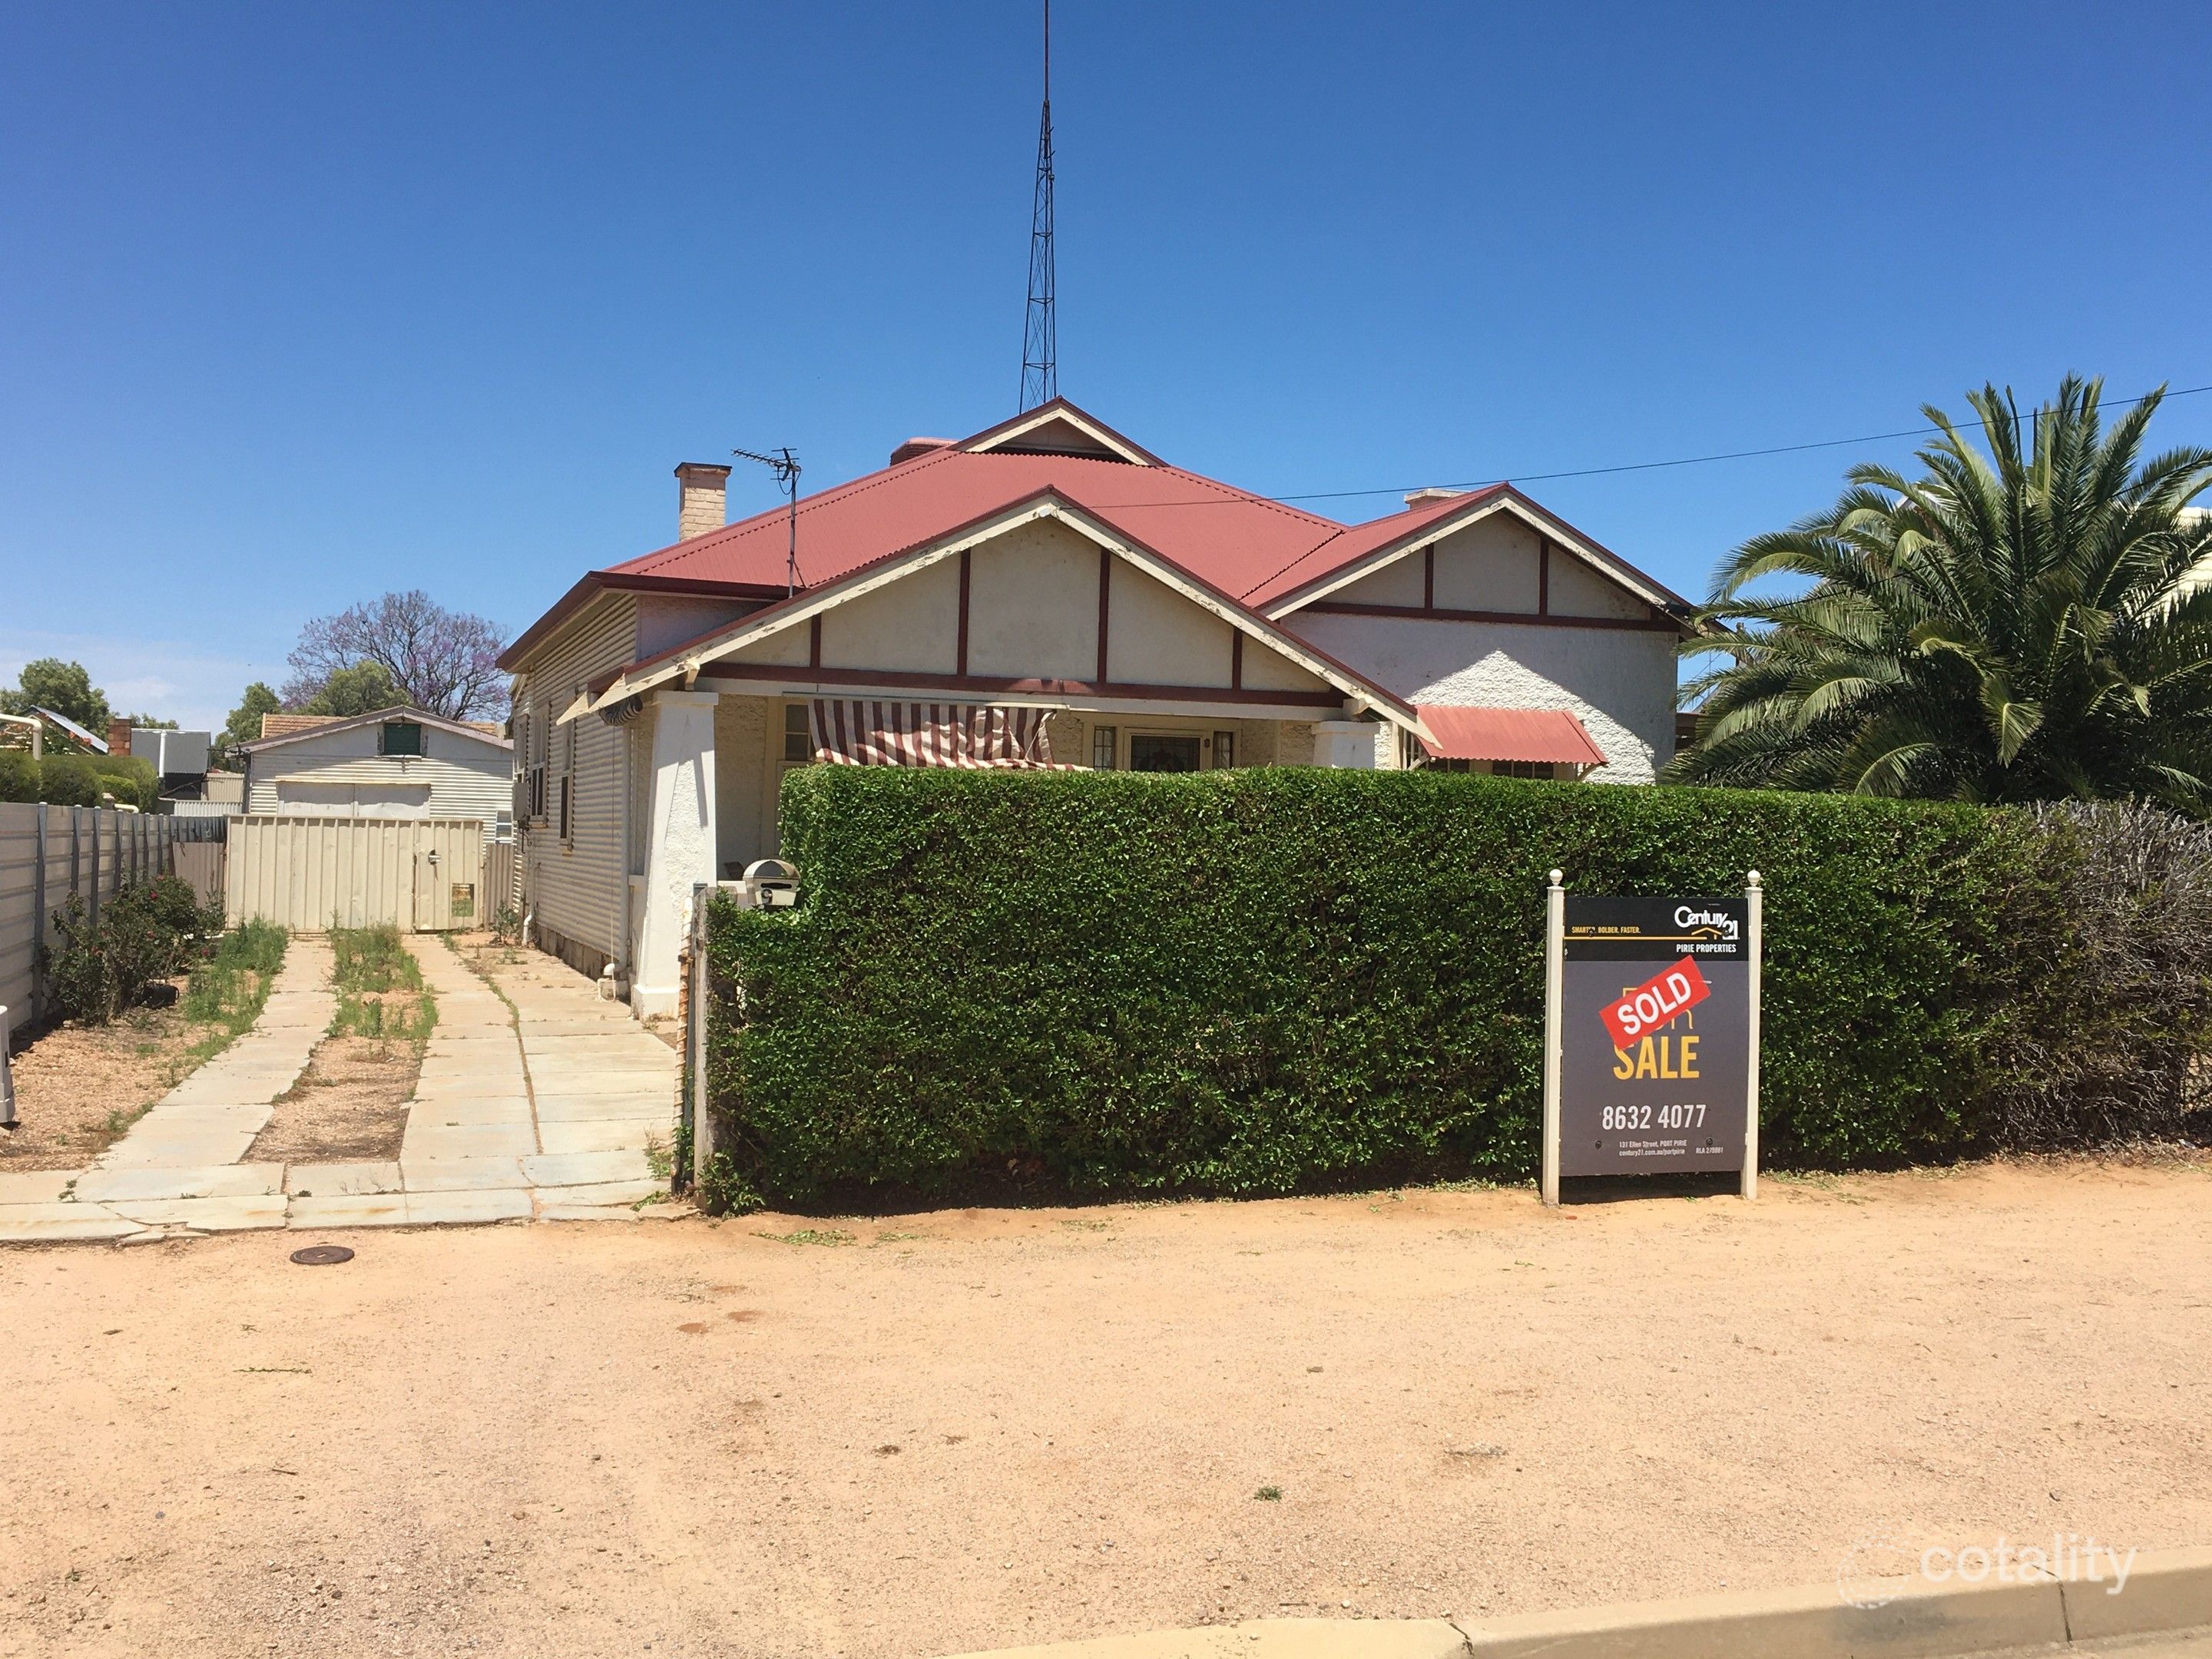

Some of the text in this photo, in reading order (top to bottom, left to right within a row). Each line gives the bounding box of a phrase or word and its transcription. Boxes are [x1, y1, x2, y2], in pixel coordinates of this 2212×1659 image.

[1674, 906, 1738, 940] Century 21
[1676, 944, 1737, 952] PIRIE PROPERTIES
[1618, 972, 1691, 1035] SOLD
[1613, 1035, 1700, 1080] SALE
[1602, 1104, 1706, 1130] 8632 4077
